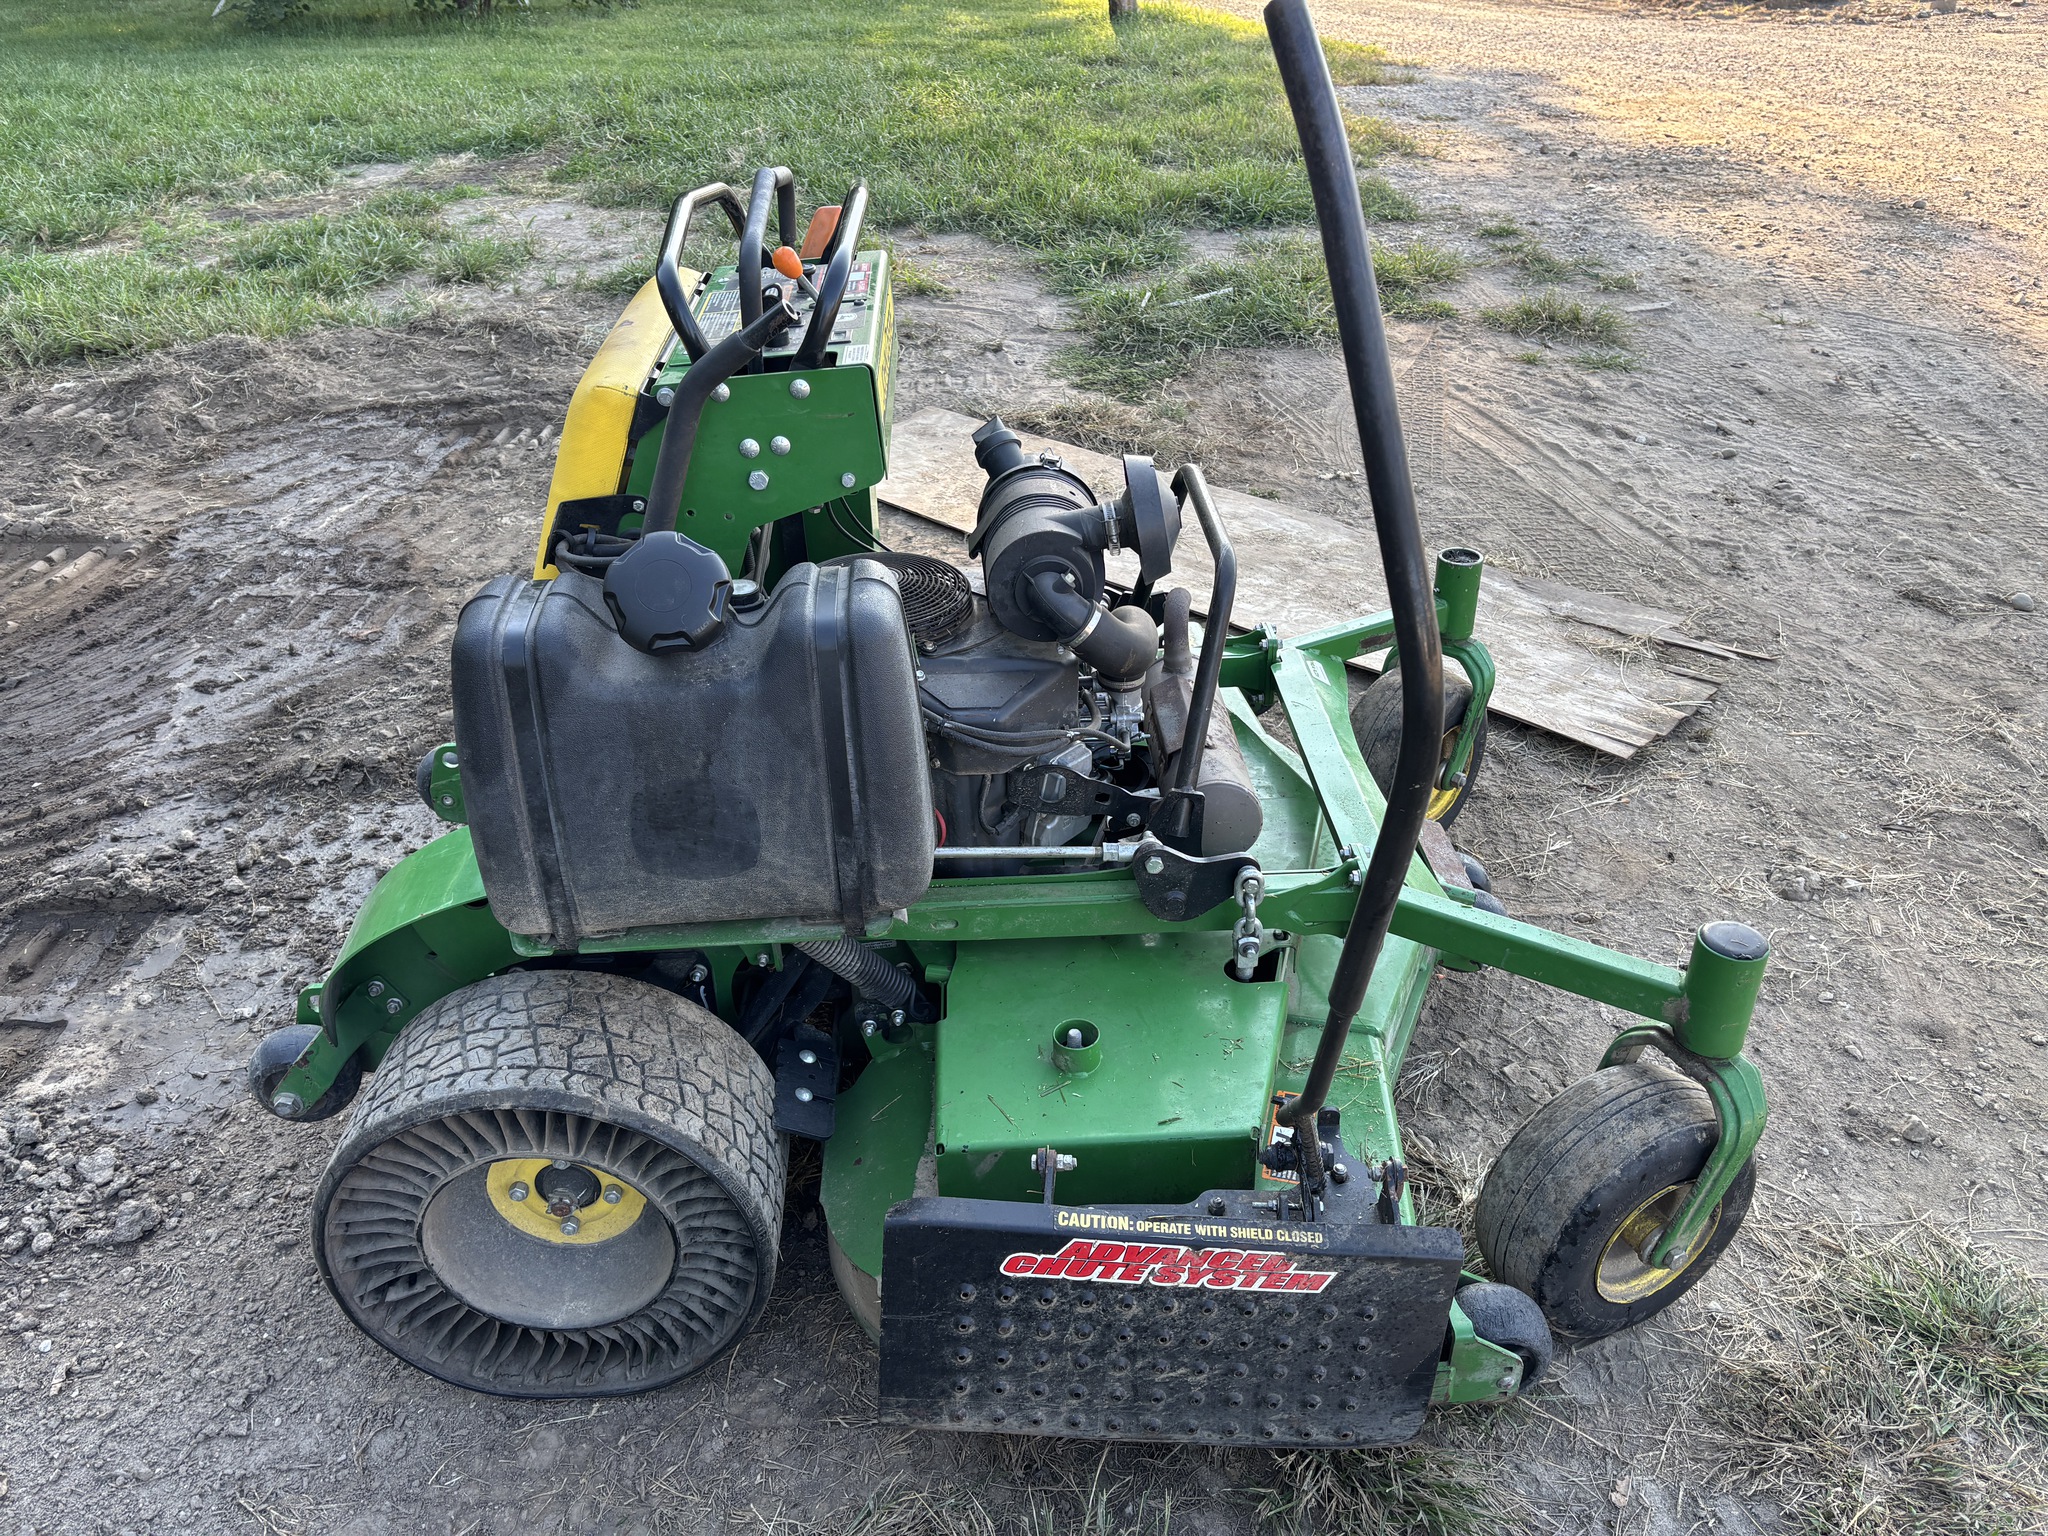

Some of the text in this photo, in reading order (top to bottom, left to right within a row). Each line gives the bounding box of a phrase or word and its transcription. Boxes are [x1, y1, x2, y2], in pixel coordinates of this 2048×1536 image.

[1057, 1211, 1323, 1243] CAUTION: OPERATE WITH SHIELD CLOSED
[1056, 1240, 1298, 1272] ADVANCED
[1002, 1254, 1334, 1292] CHUTE SYSTEM
